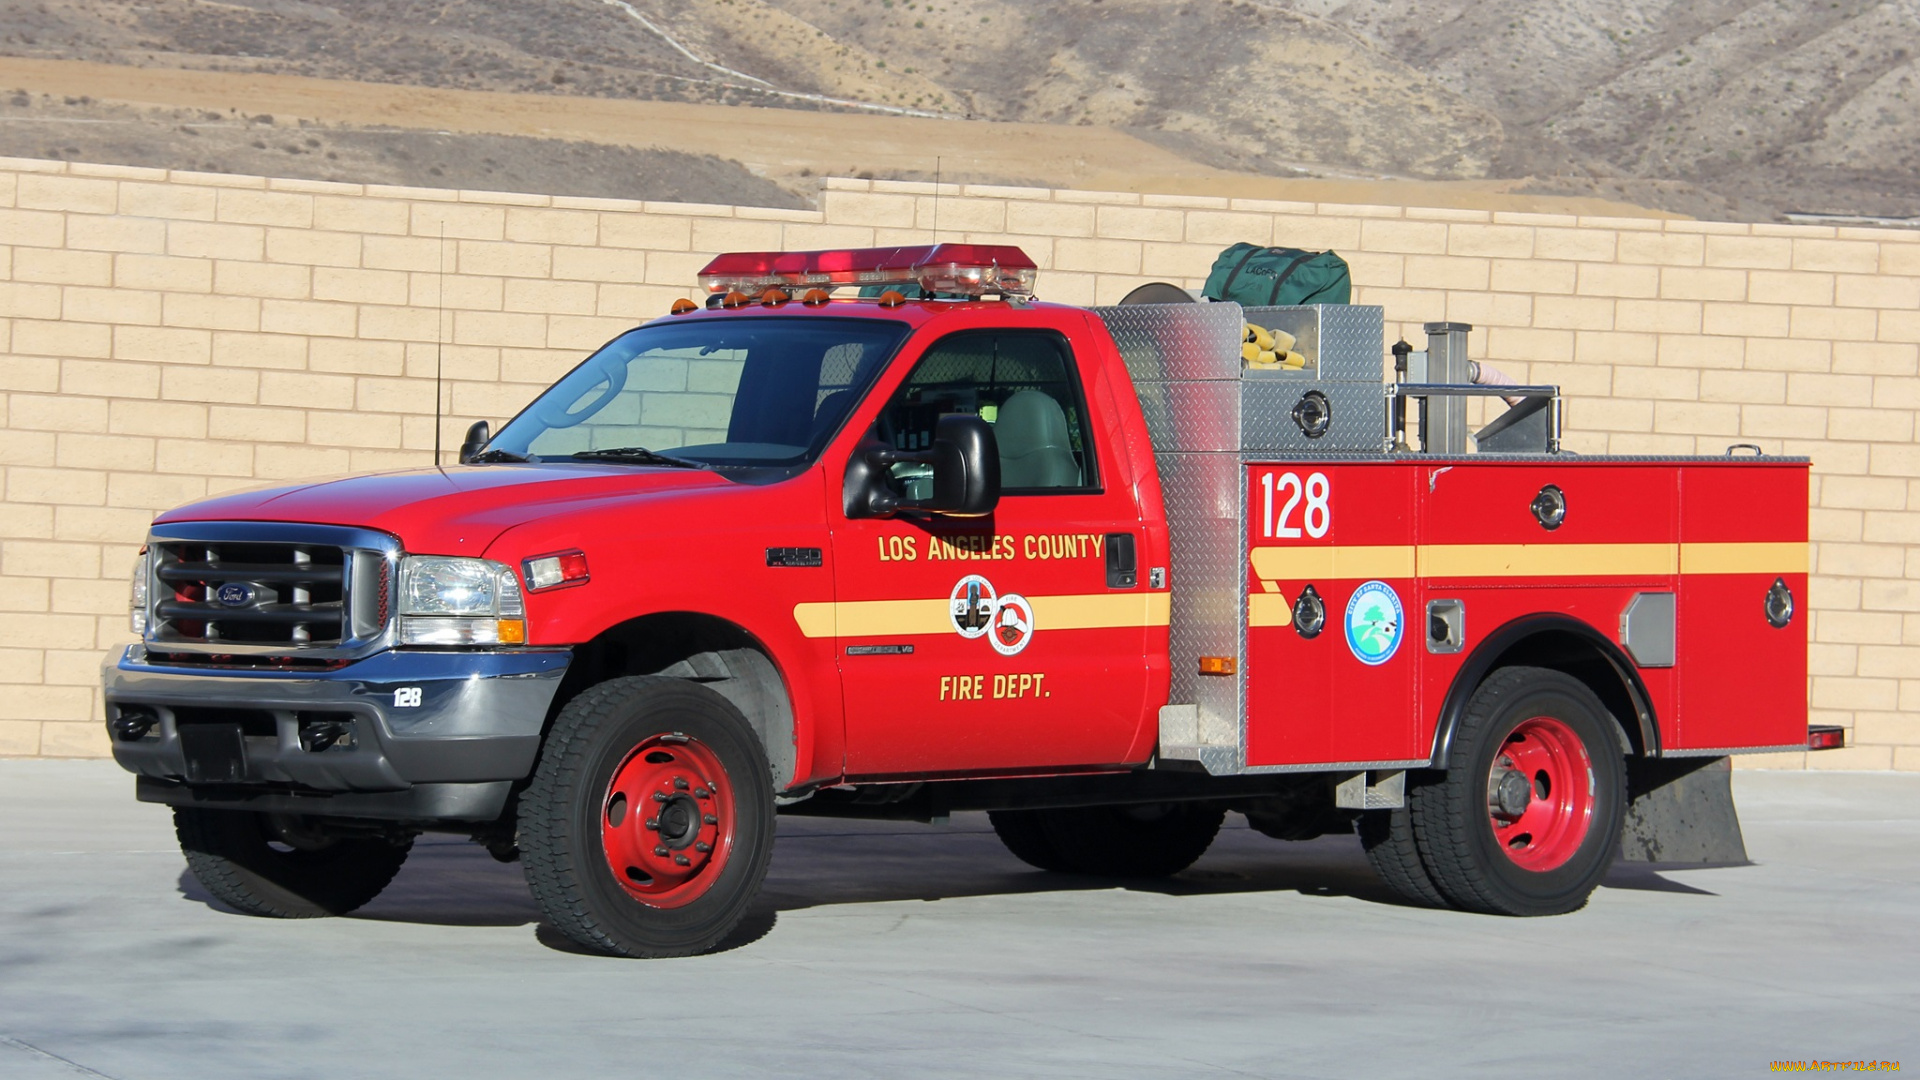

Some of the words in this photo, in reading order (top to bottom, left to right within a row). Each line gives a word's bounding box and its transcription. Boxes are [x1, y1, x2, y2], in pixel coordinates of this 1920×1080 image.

[1261, 472, 1330, 539] 128
[878, 536, 917, 561] LOS
[927, 535, 1015, 560] ANGELES
[1024, 534, 1104, 560] COUNTY
[223, 587, 244, 601] Ford
[1363, 583, 1382, 592] SANTA
[994, 640, 1026, 653] DEPARTMENT
[394, 687, 422, 707] 128
[940, 676, 984, 701] FIRE
[993, 673, 1050, 699] DEPT.
